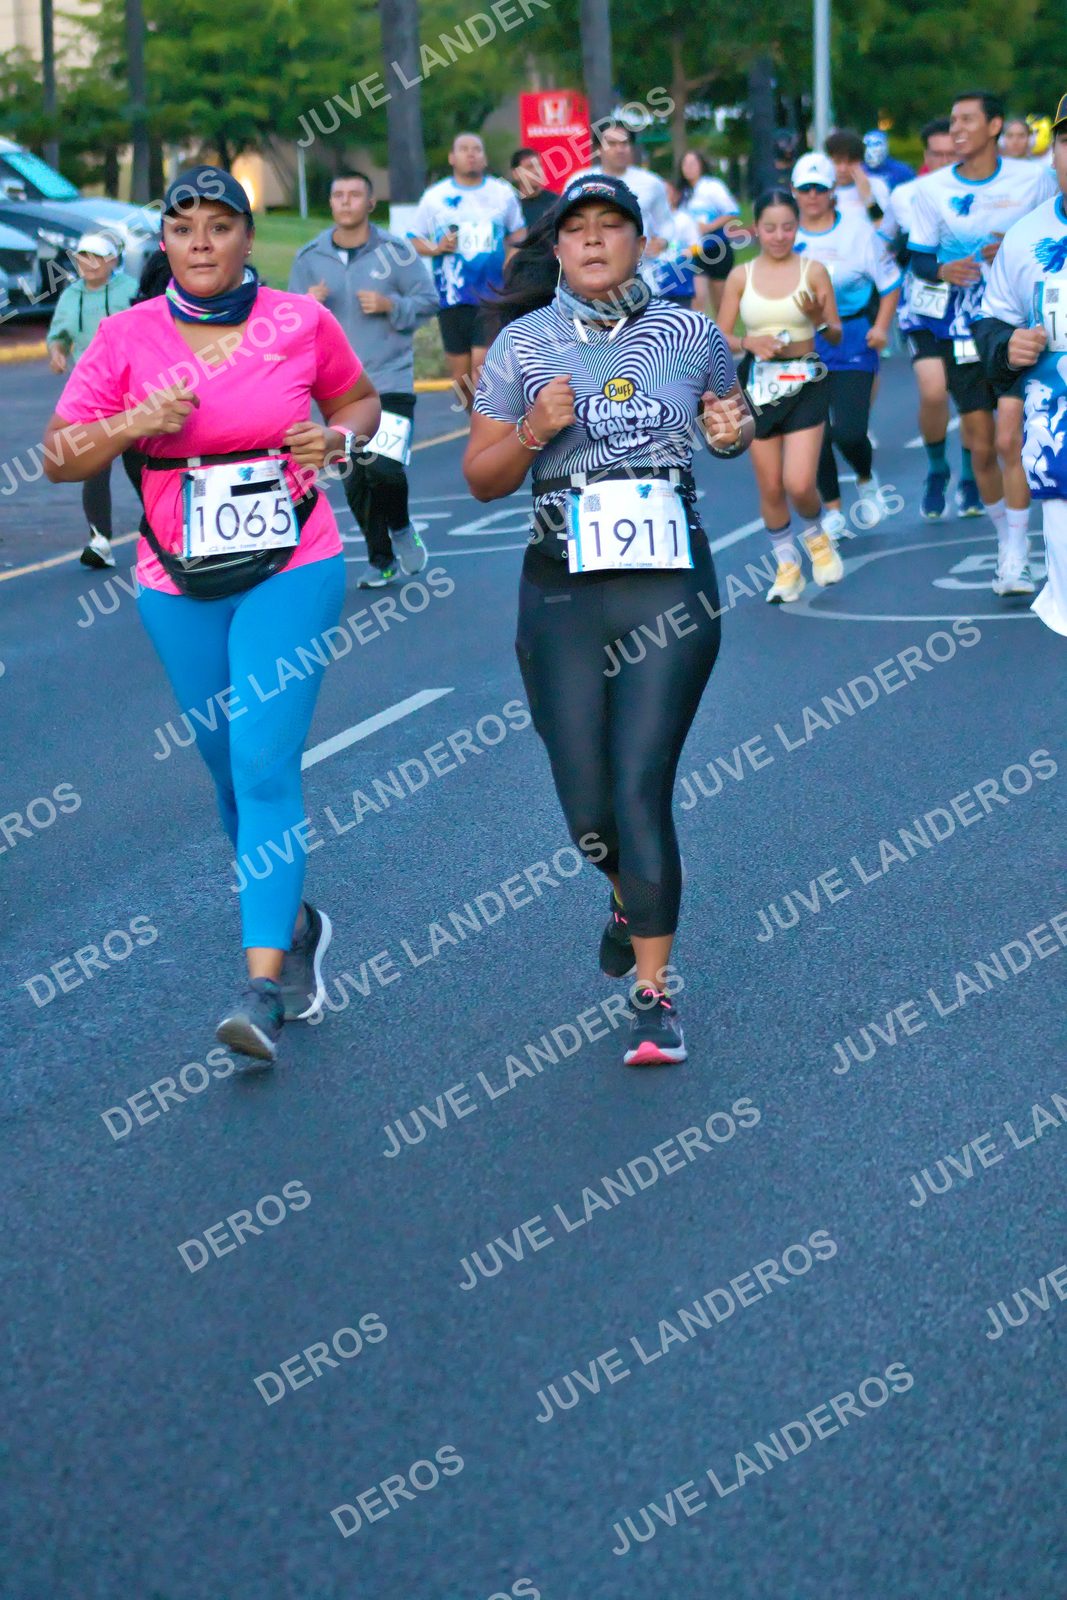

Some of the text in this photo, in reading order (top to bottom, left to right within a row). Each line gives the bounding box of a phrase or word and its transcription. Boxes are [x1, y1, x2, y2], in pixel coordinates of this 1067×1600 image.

[1048, 311, 1067, 341] 1
[587, 390, 661, 423] FONGUS
[587, 415, 661, 440] TRAIL 2018
[608, 430, 650, 448] RACE
[196, 497, 291, 543] 1065
[589, 518, 678, 557] 1911
